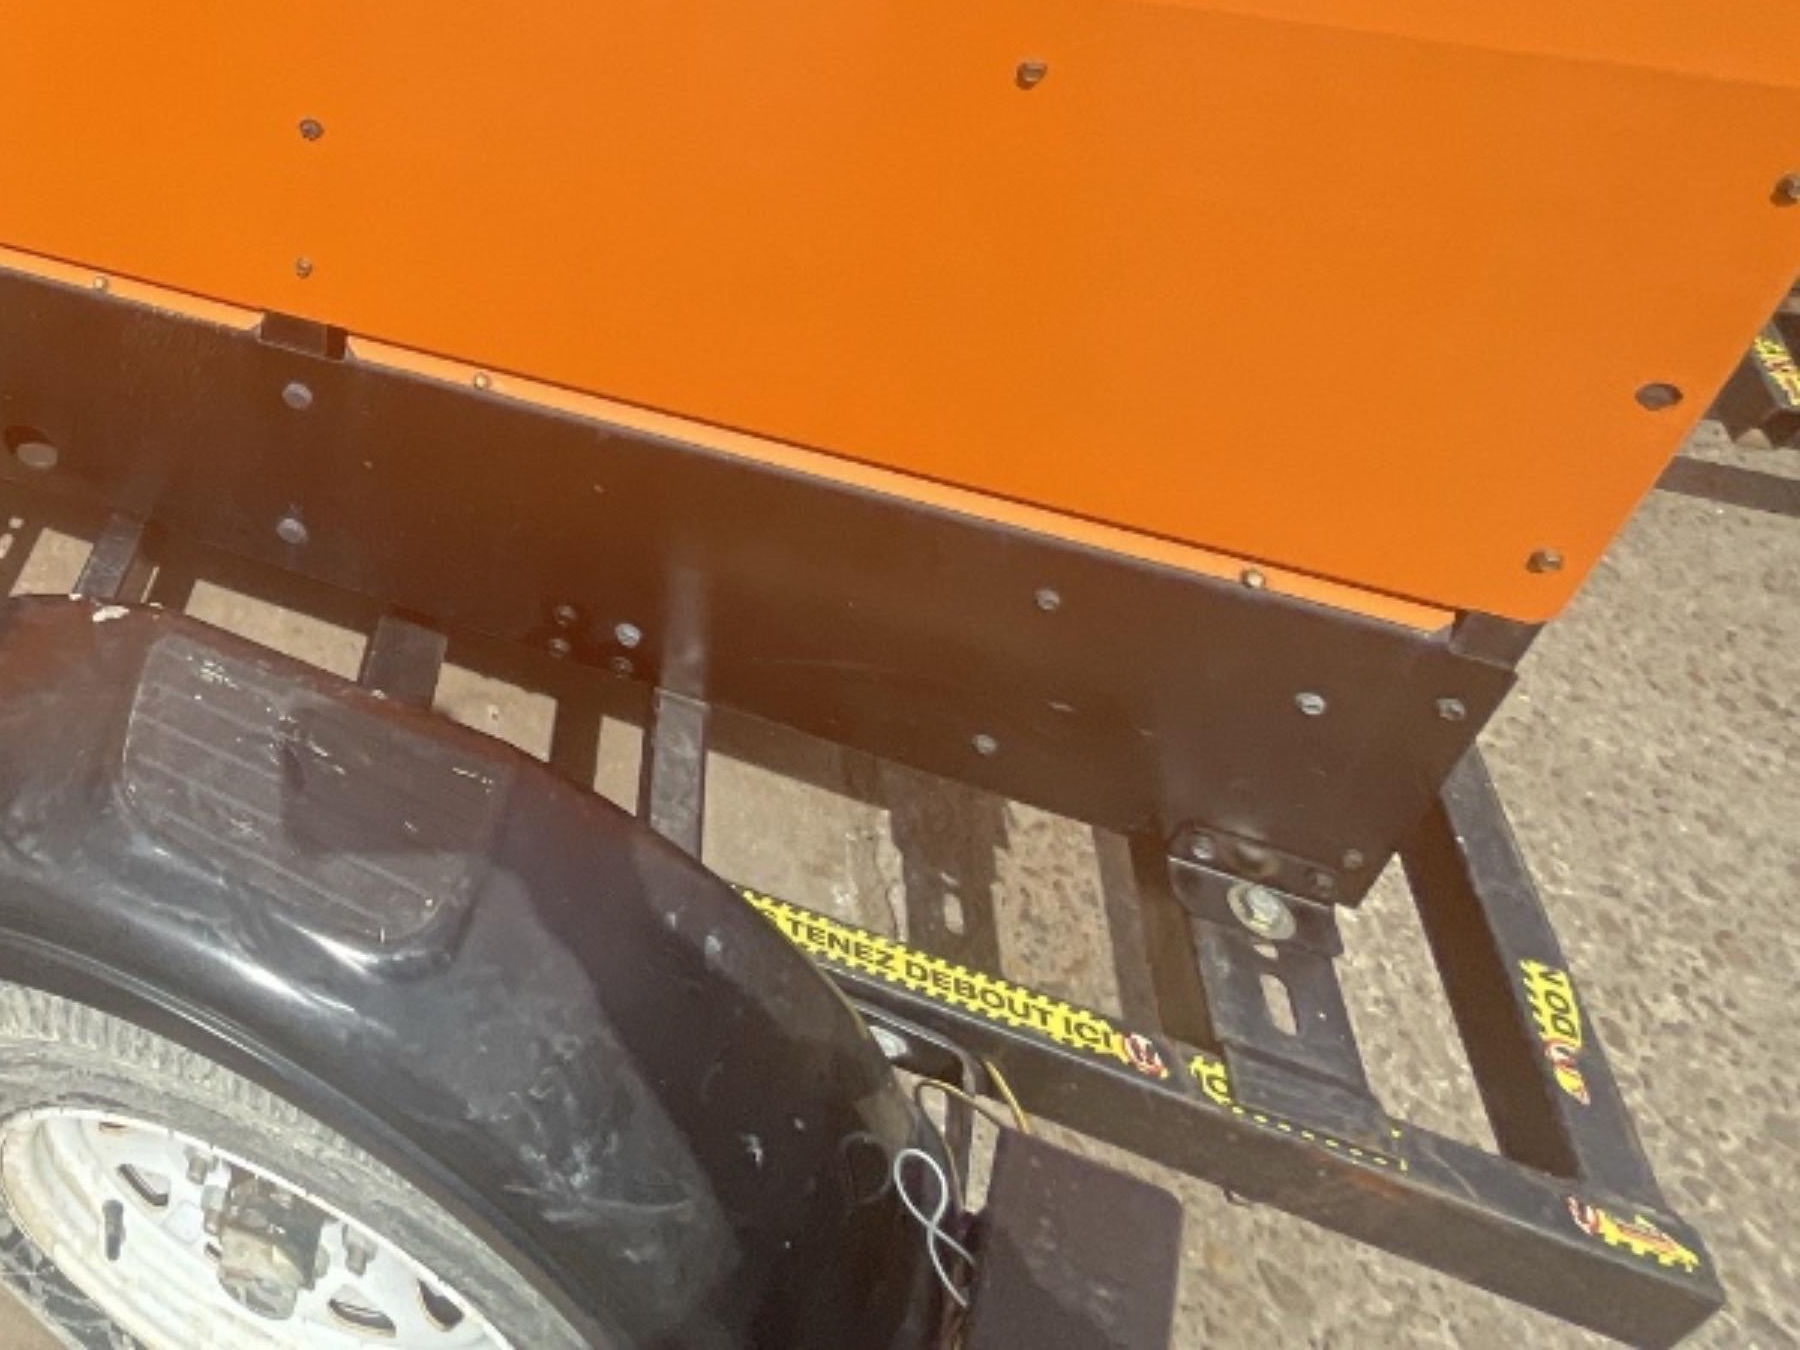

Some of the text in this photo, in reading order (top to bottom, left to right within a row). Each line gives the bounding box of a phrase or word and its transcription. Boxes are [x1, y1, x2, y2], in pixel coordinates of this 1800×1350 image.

[785, 916, 1112, 1049] TENEZ DEBOUT ICI
